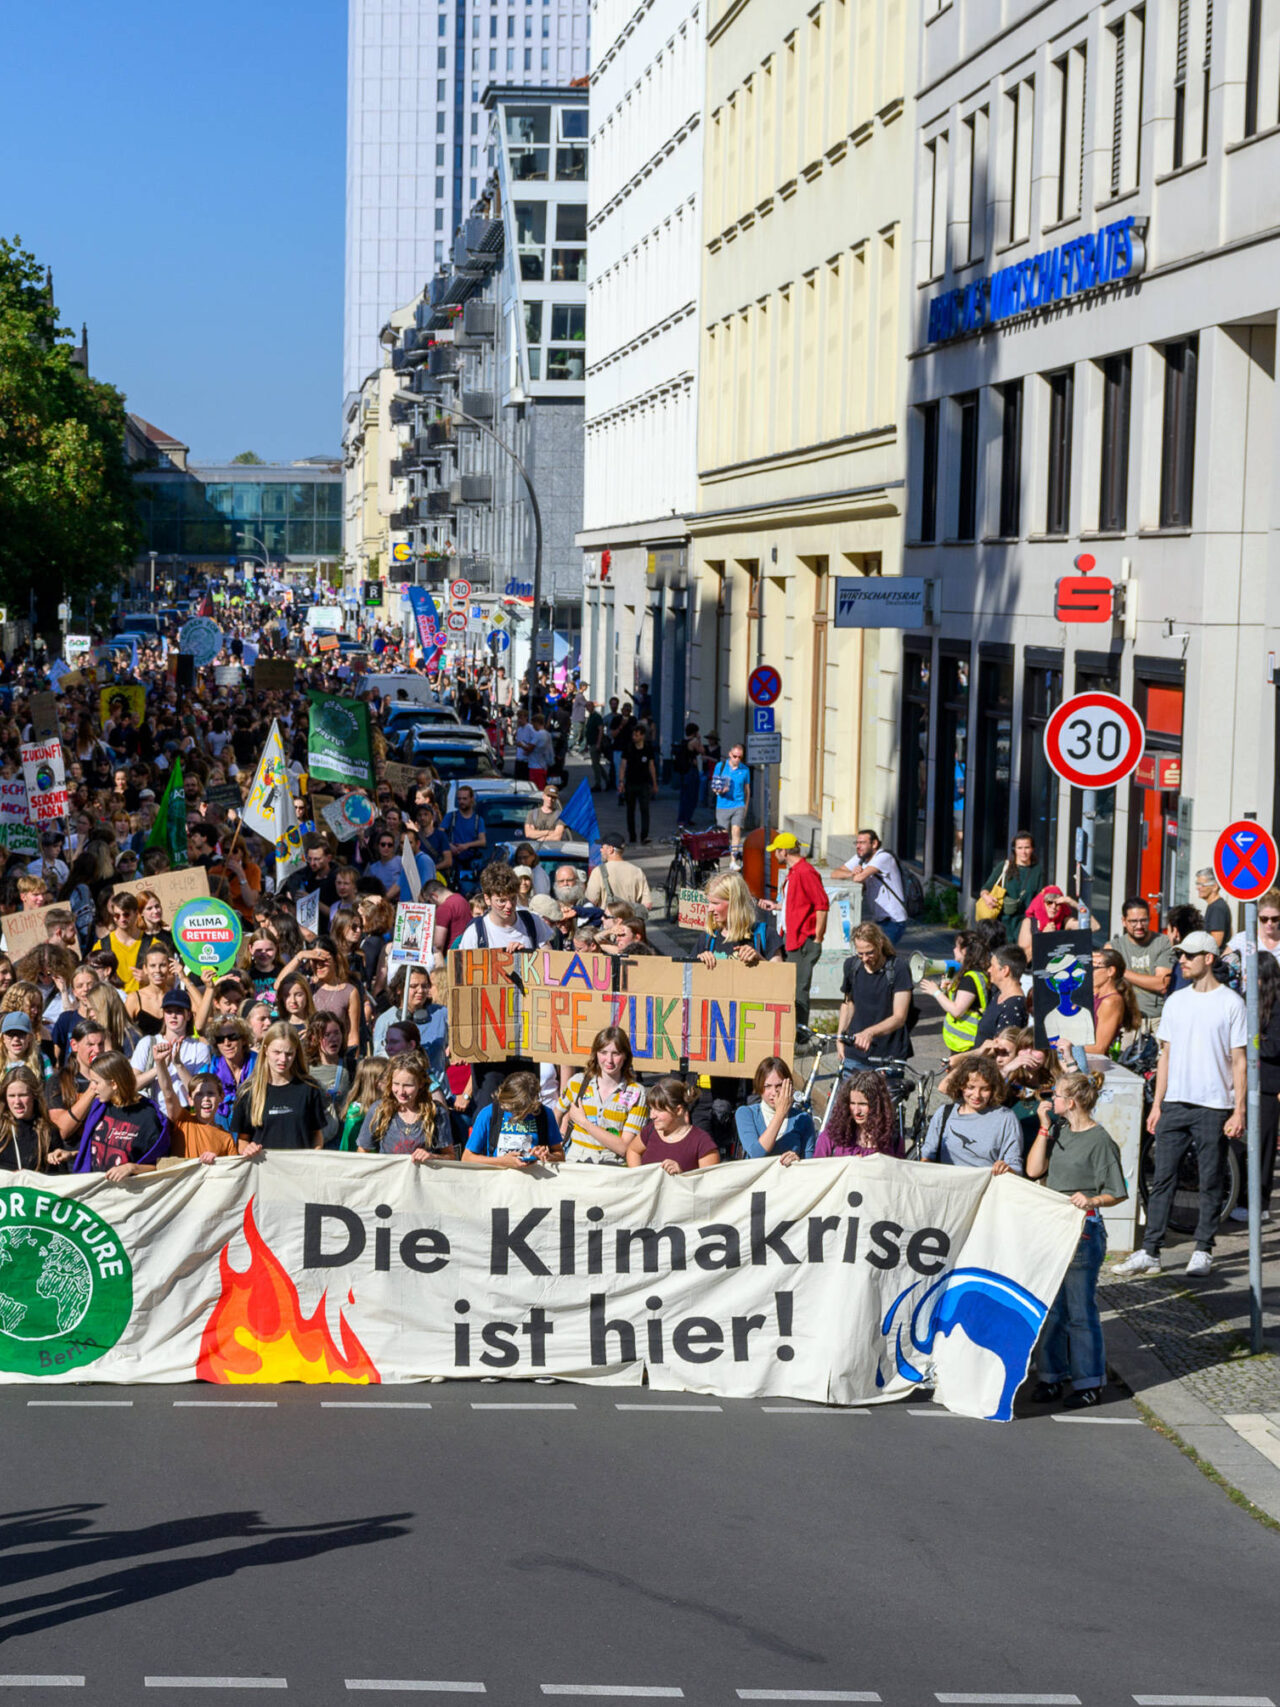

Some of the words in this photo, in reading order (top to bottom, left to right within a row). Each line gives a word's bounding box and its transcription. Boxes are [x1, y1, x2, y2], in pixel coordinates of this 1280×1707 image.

[455, 585, 467, 594] 30
[505, 577, 533, 596] dm
[840, 592, 921, 600] WIRTSCHAFTSRAT
[757, 710, 769, 729] P
[1067, 719, 1122, 762] 30
[22, 744, 61, 762] ZUKUNFT
[37, 806, 64, 820] FADEN
[189, 917, 222, 927] KLIMA
[186, 931, 229, 940] RETTEN!
[451, 950, 515, 987] IHR
[523, 951, 639, 992] KLAUT
[452, 987, 593, 1061] UNSERE
[602, 993, 792, 1063] ZUKUNFT
[35, 1195, 123, 1280] FUTURE
[302, 1202, 450, 1274] Die
[491, 1190, 950, 1276] Klimakrise
[452, 1297, 554, 1368] ist
[588, 1290, 795, 1366] hier!
[38, 1337, 97, 1369] Berlin
